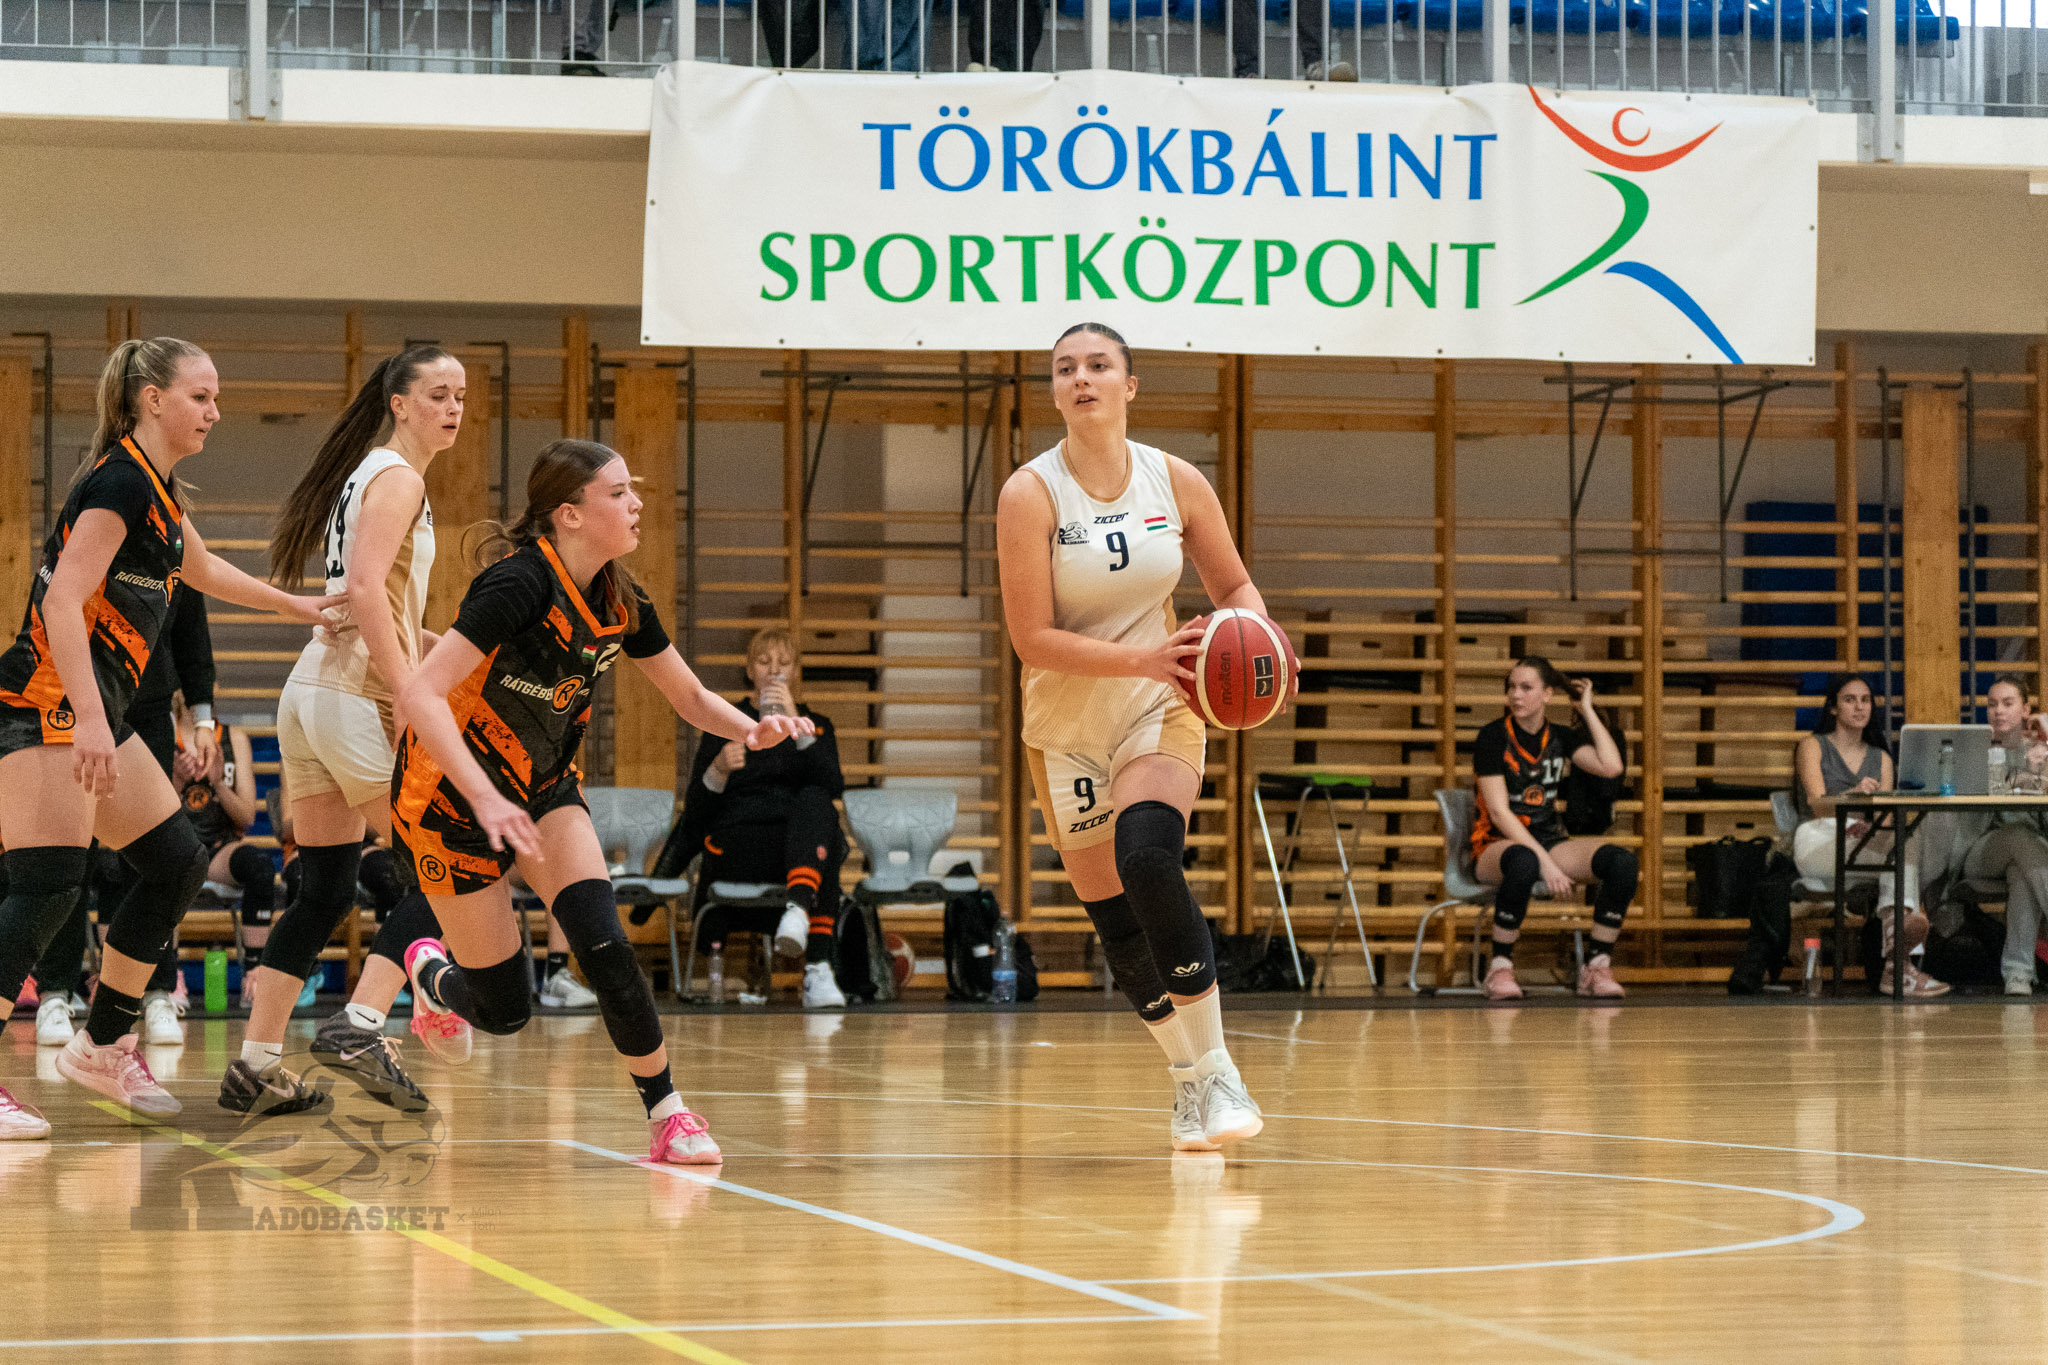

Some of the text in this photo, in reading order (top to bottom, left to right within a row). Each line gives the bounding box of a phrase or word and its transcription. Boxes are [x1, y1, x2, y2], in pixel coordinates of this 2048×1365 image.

[862, 105, 1498, 200] TÖRÖKBÁLINT
[759, 216, 1497, 309] SPORTKÖZPONT
[1105, 531, 1130, 572] 9
[1541, 757, 1564, 785] 17
[1074, 777, 1096, 814] 9
